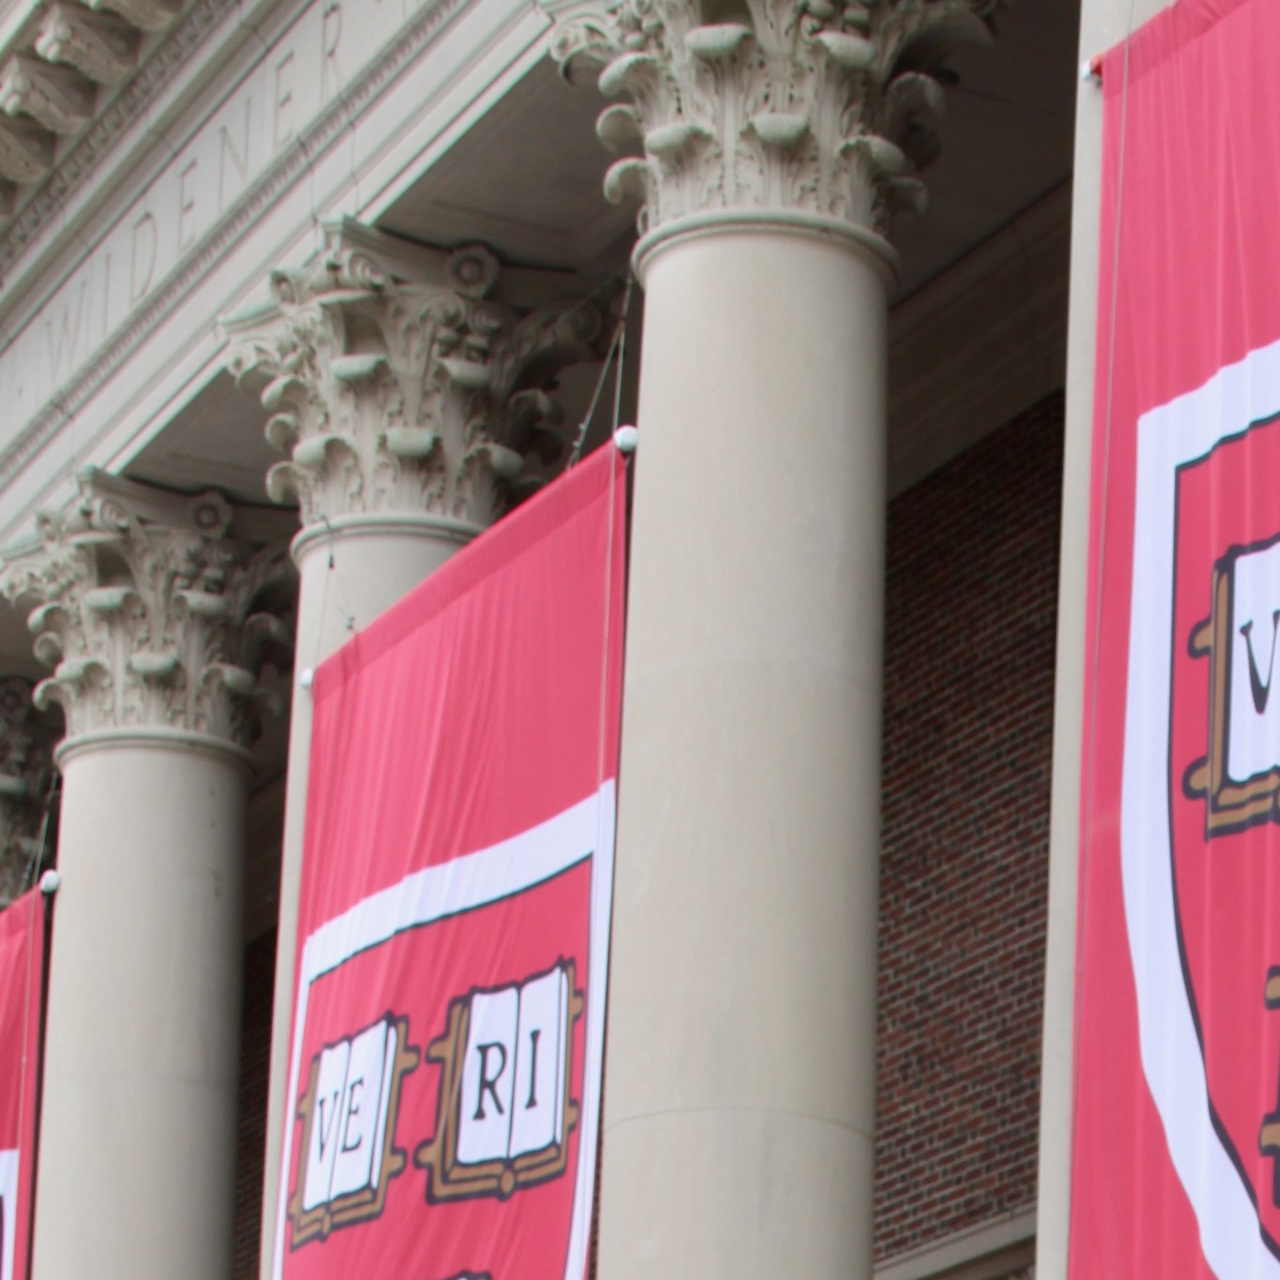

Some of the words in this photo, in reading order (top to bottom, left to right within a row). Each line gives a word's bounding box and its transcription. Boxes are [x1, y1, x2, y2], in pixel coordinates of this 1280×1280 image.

[45, 2, 347, 380] WIDENER
[317, 1077, 365, 1160] VE
[471, 1029, 542, 1121] RI
